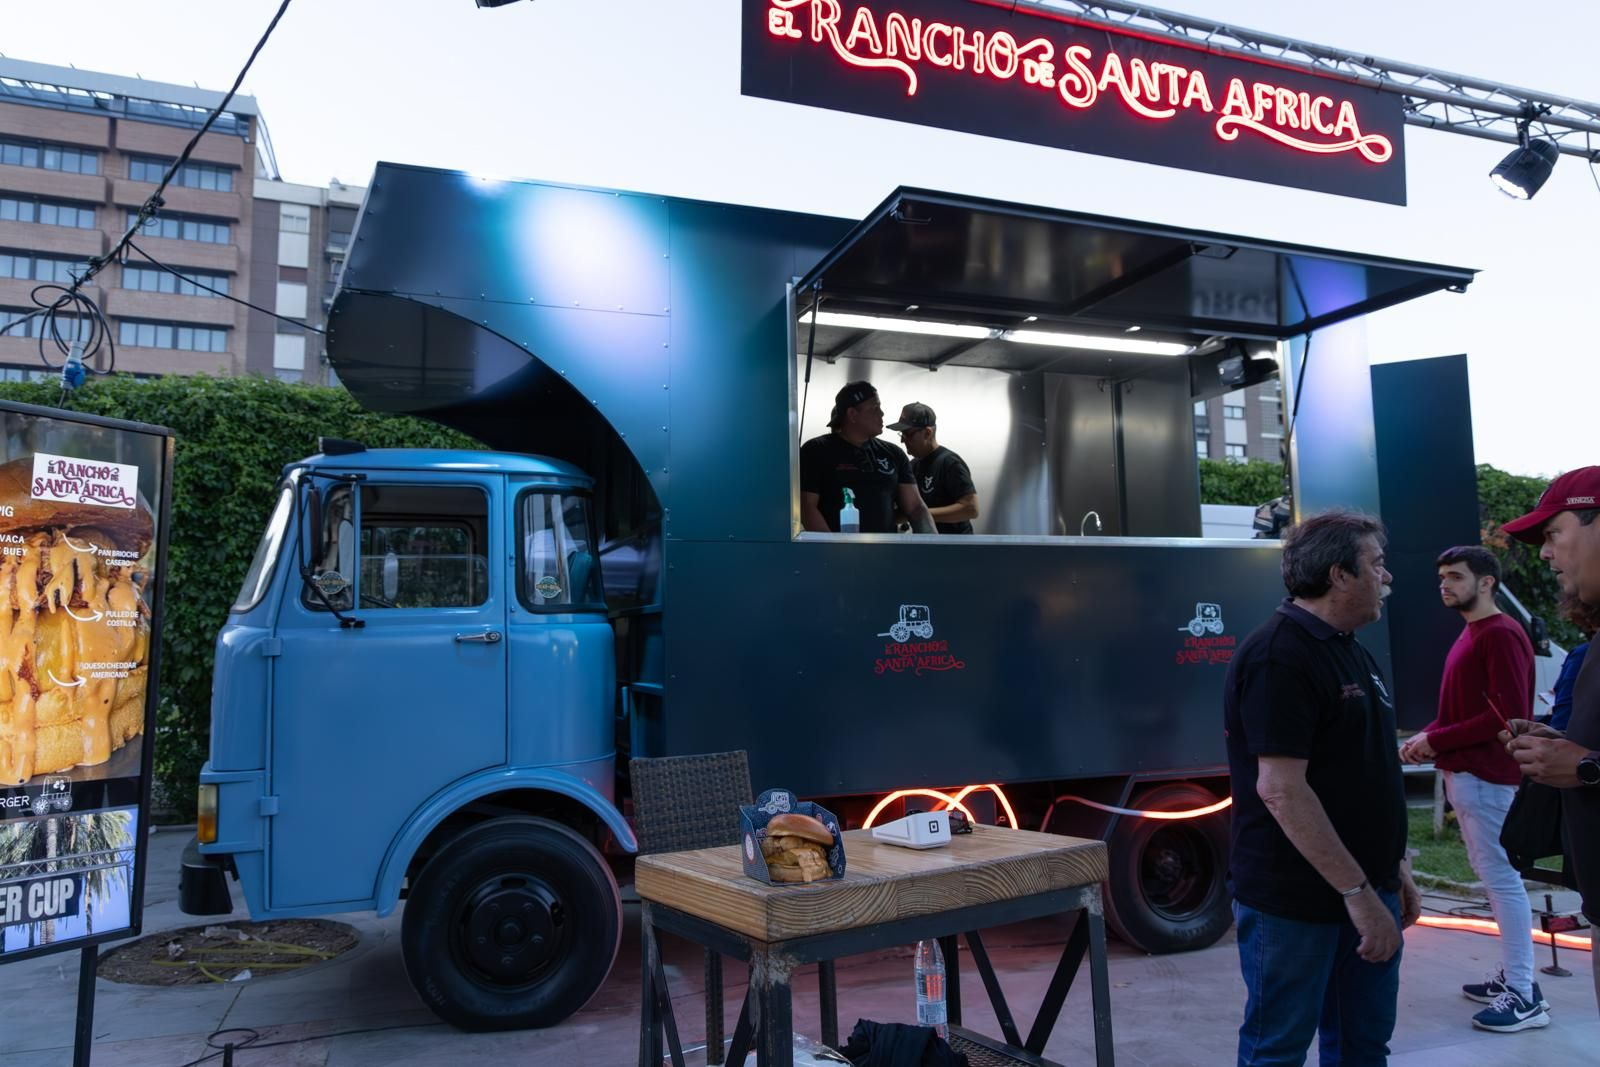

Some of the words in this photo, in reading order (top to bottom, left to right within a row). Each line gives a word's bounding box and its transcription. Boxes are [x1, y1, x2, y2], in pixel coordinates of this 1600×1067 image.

[768, 7, 803, 38] EL
[808, 0, 1055, 96] RANCHO
[1023, 58, 1056, 88] DE
[1059, 45, 1213, 119] SANTA
[56, 460, 119, 487] RANCHO
[32, 477, 80, 499] SANTA
[0, 505, 14, 517] IG
[3, 547, 28, 556] BUEY
[98, 549, 112, 557] PAN
[112, 550, 139, 559] BRIOCHE
[105, 610, 130, 618] PULLED
[106, 661, 137, 670] CHEDDAR
[90, 671, 129, 679] AMERICANO
[28, 878, 75, 919] CUP
